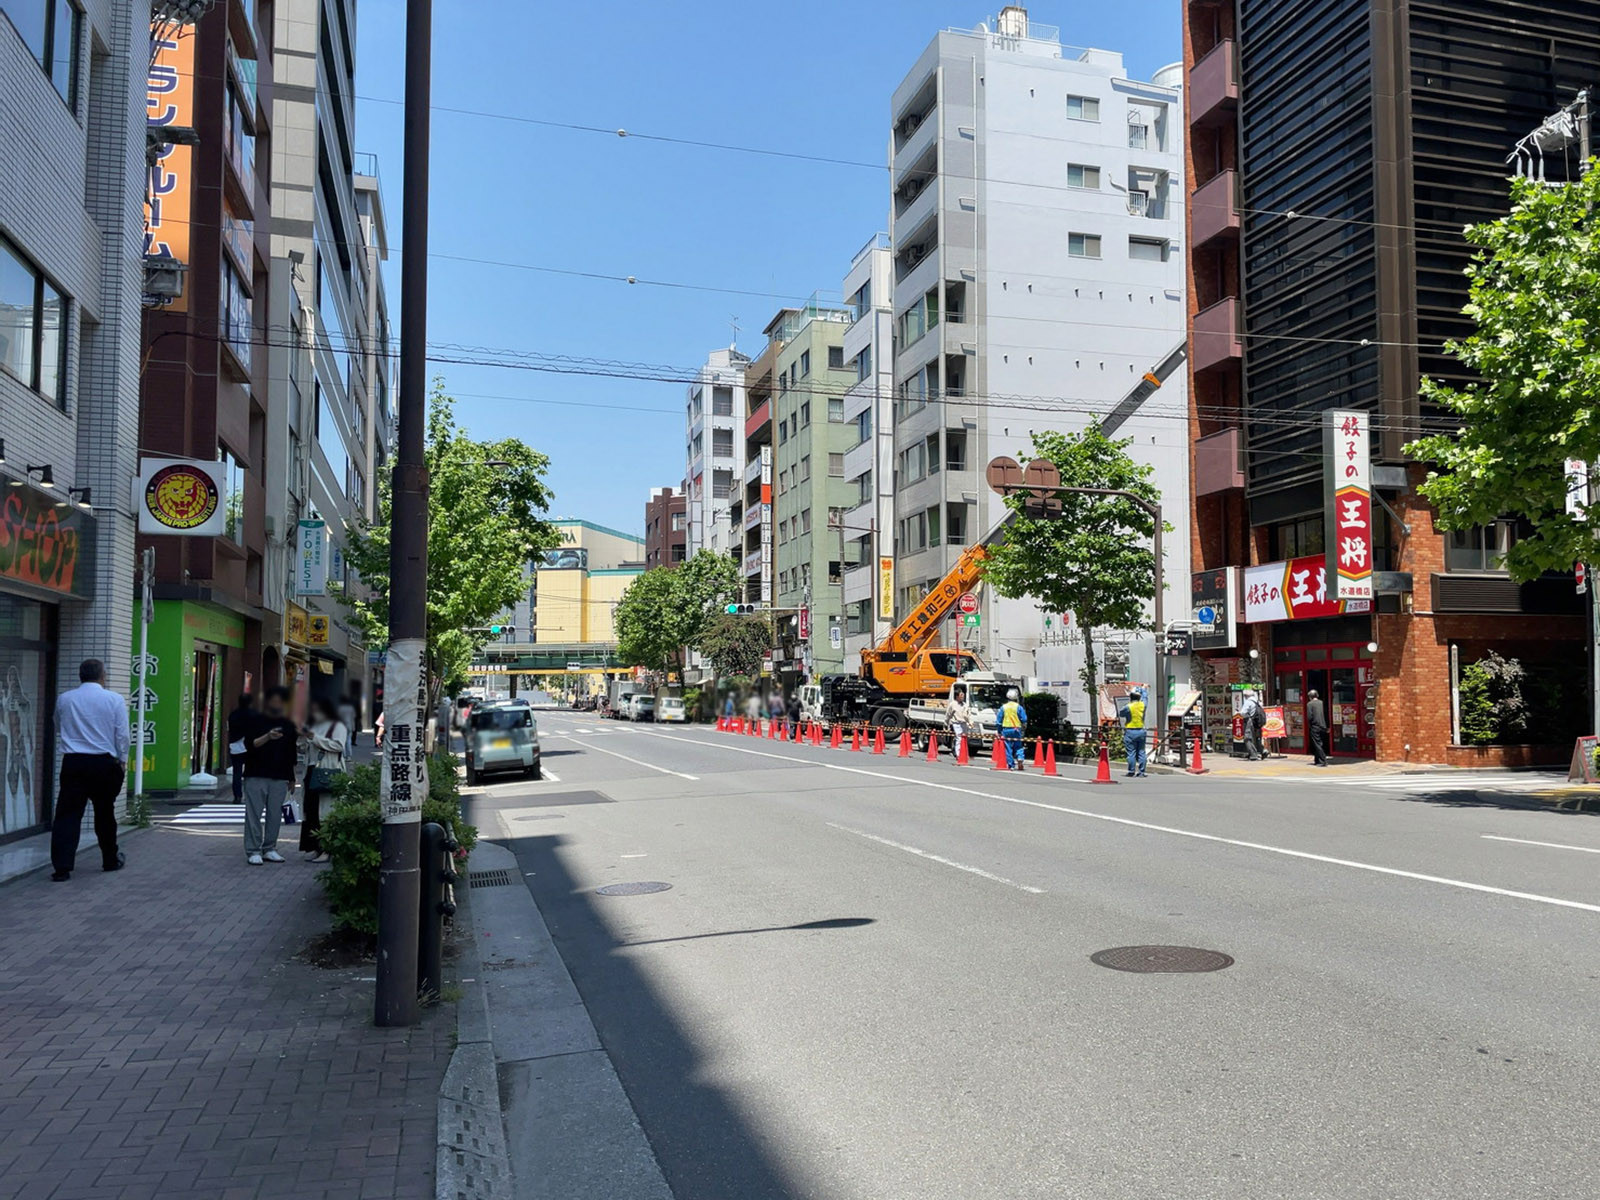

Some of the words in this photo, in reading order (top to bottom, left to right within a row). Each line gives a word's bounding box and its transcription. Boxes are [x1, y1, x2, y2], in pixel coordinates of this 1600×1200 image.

[1341, 416, 1361, 478] 餃子の
[147, 493, 155, 508] NEW
[152, 508, 173, 525] JAPAN
[172, 496, 217, 528] PRO-WRESTLING
[1340, 500, 1368, 568] 王将
[304, 530, 313, 588] FOREST
[1247, 582, 1280, 606] 餃子の
[1340, 586, 1371, 596] 水道橋店
[131, 652, 158, 745] お弁当
[390, 724, 412, 802] 重点路線
